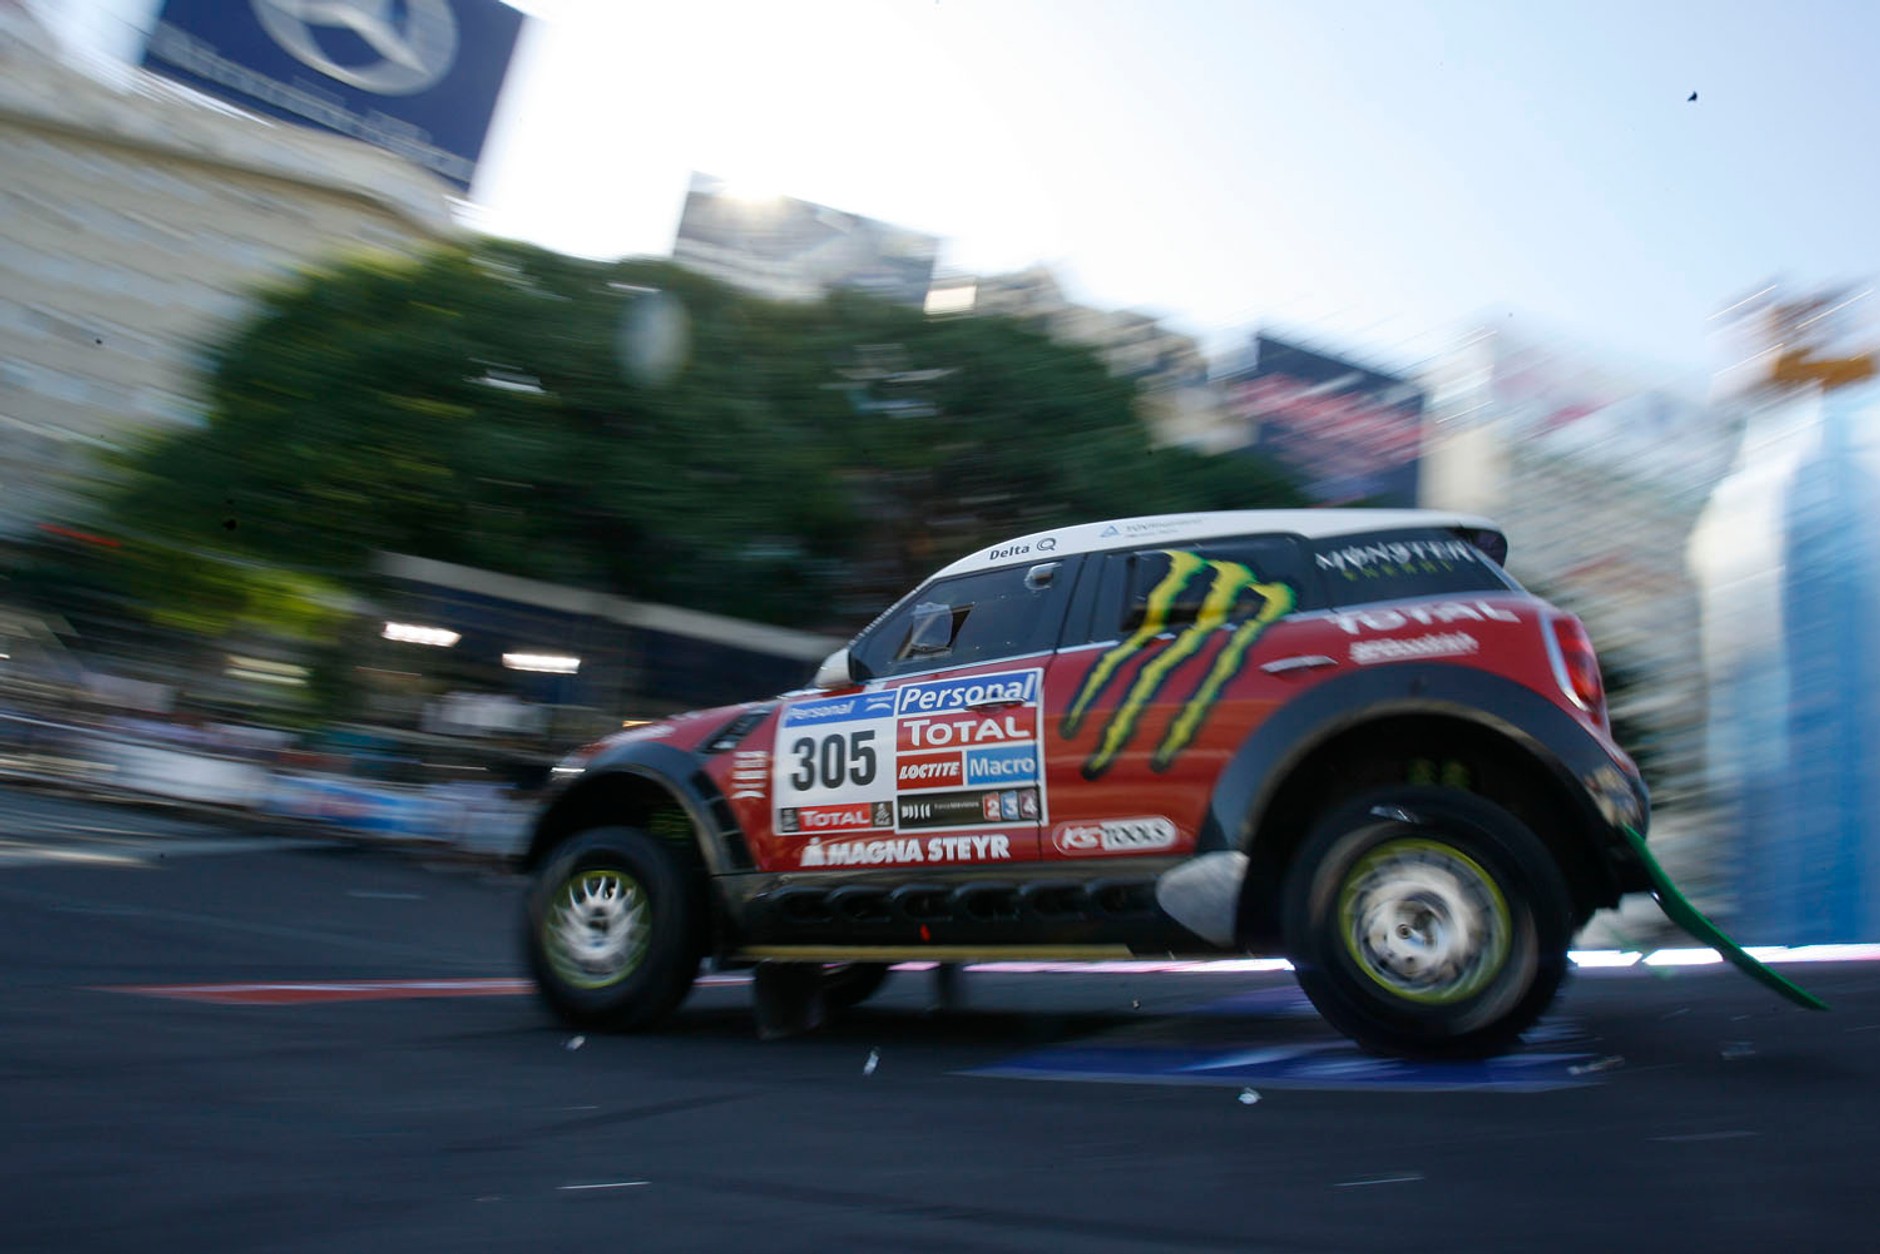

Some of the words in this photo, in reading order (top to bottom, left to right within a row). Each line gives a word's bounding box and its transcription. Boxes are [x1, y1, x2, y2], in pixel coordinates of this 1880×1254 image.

[989, 546, 1030, 560] Delta
[1322, 600, 1521, 635] TOTAL
[901, 674, 1035, 711] Personal
[788, 700, 855, 720] Personal
[903, 716, 1031, 746] TOTAL
[791, 730, 877, 791] 305
[899, 762, 960, 780] LOCTITE
[970, 757, 1036, 777] Macro
[800, 810, 870, 827] TOTAL
[827, 838, 924, 866] MAGNA
[928, 834, 1011, 862] STEYR
